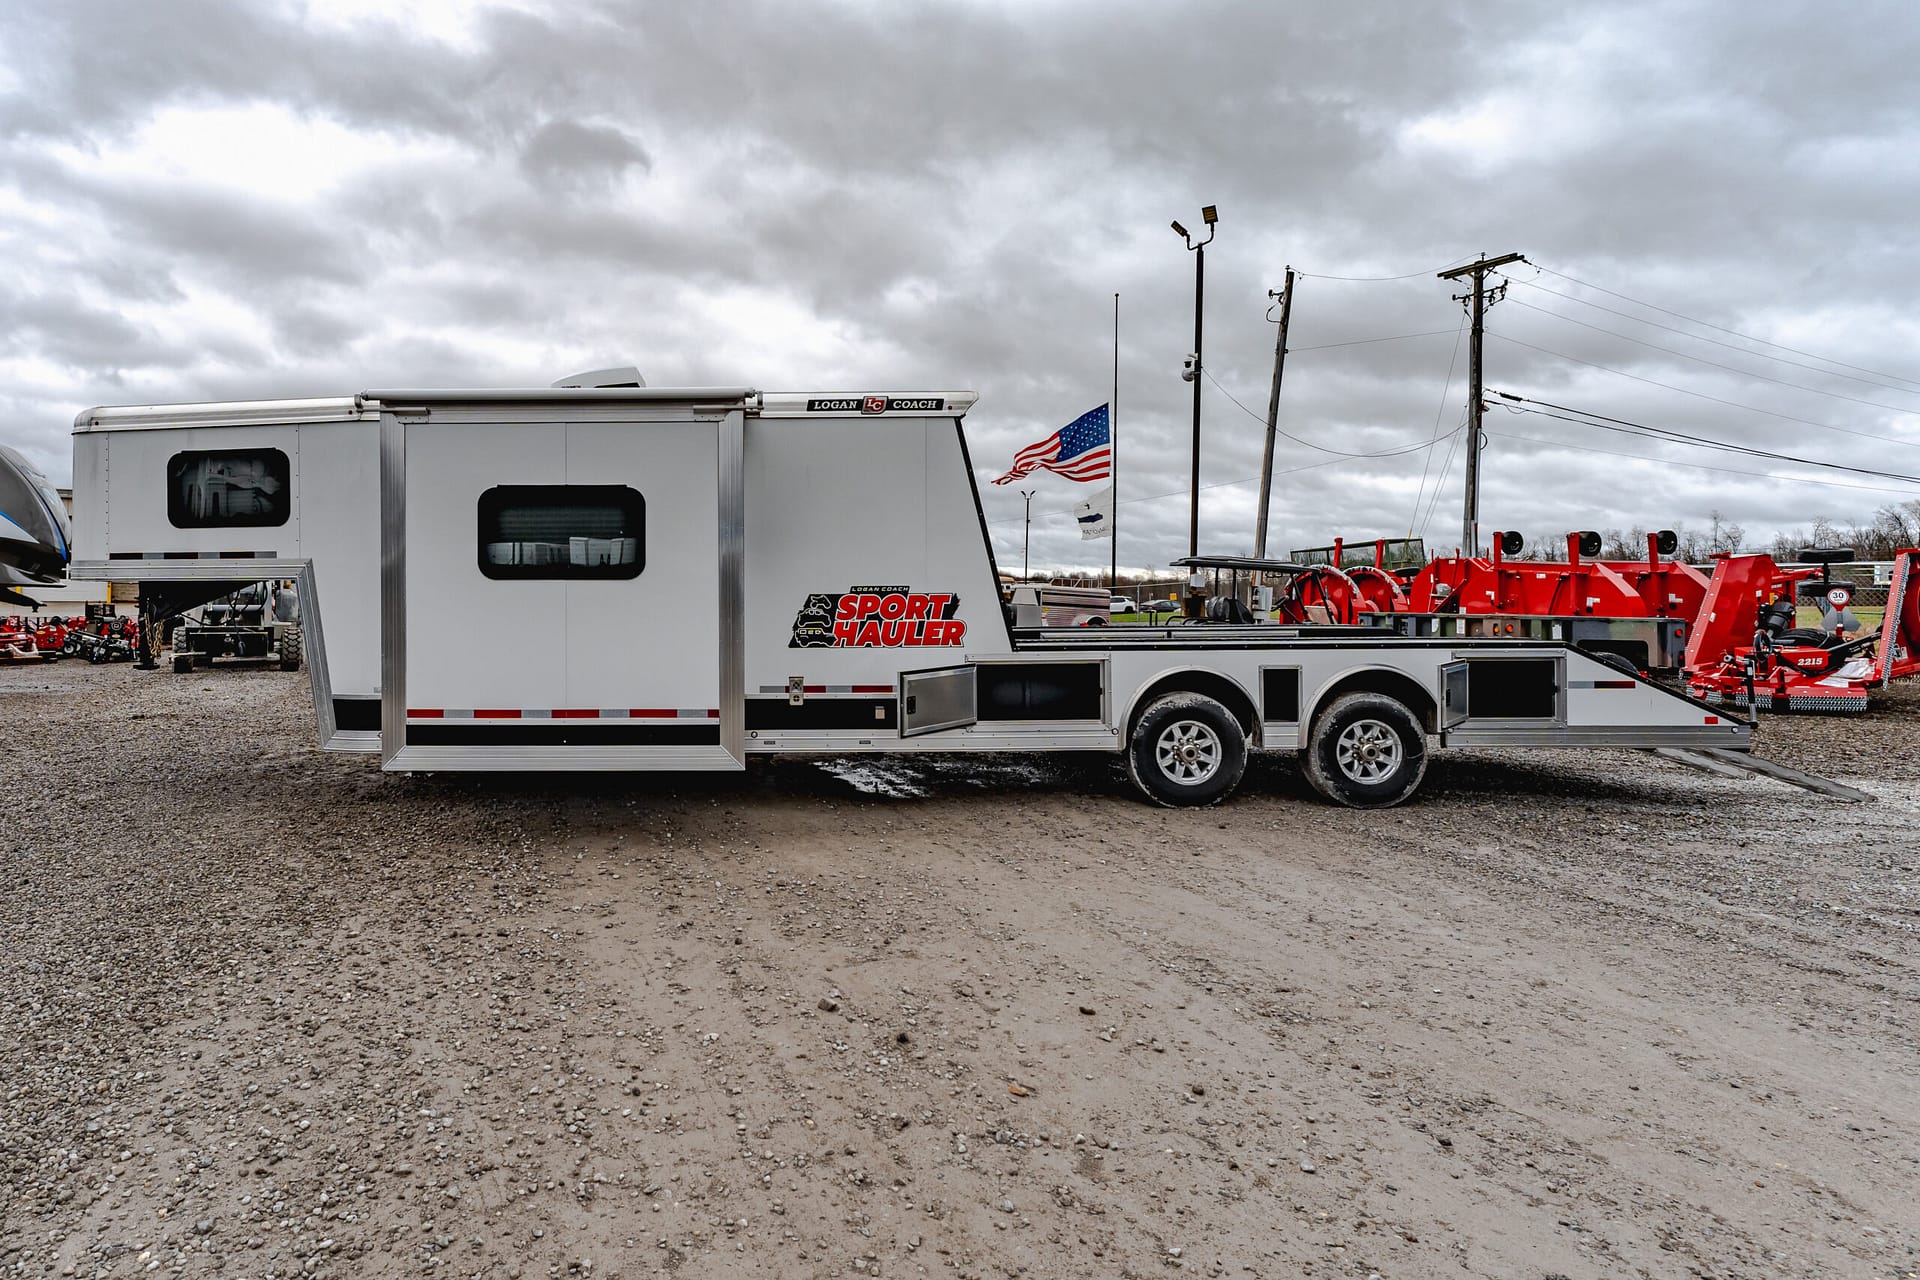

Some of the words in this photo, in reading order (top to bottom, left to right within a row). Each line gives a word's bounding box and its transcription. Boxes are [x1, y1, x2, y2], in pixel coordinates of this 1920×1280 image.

[814, 400, 857, 410] LOGAN
[866, 399, 882, 411] LC
[893, 400, 938, 409] COACH
[836, 593, 952, 620] SPORT
[833, 619, 966, 647] HAULER
[1797, 658, 1823, 666] 2215
